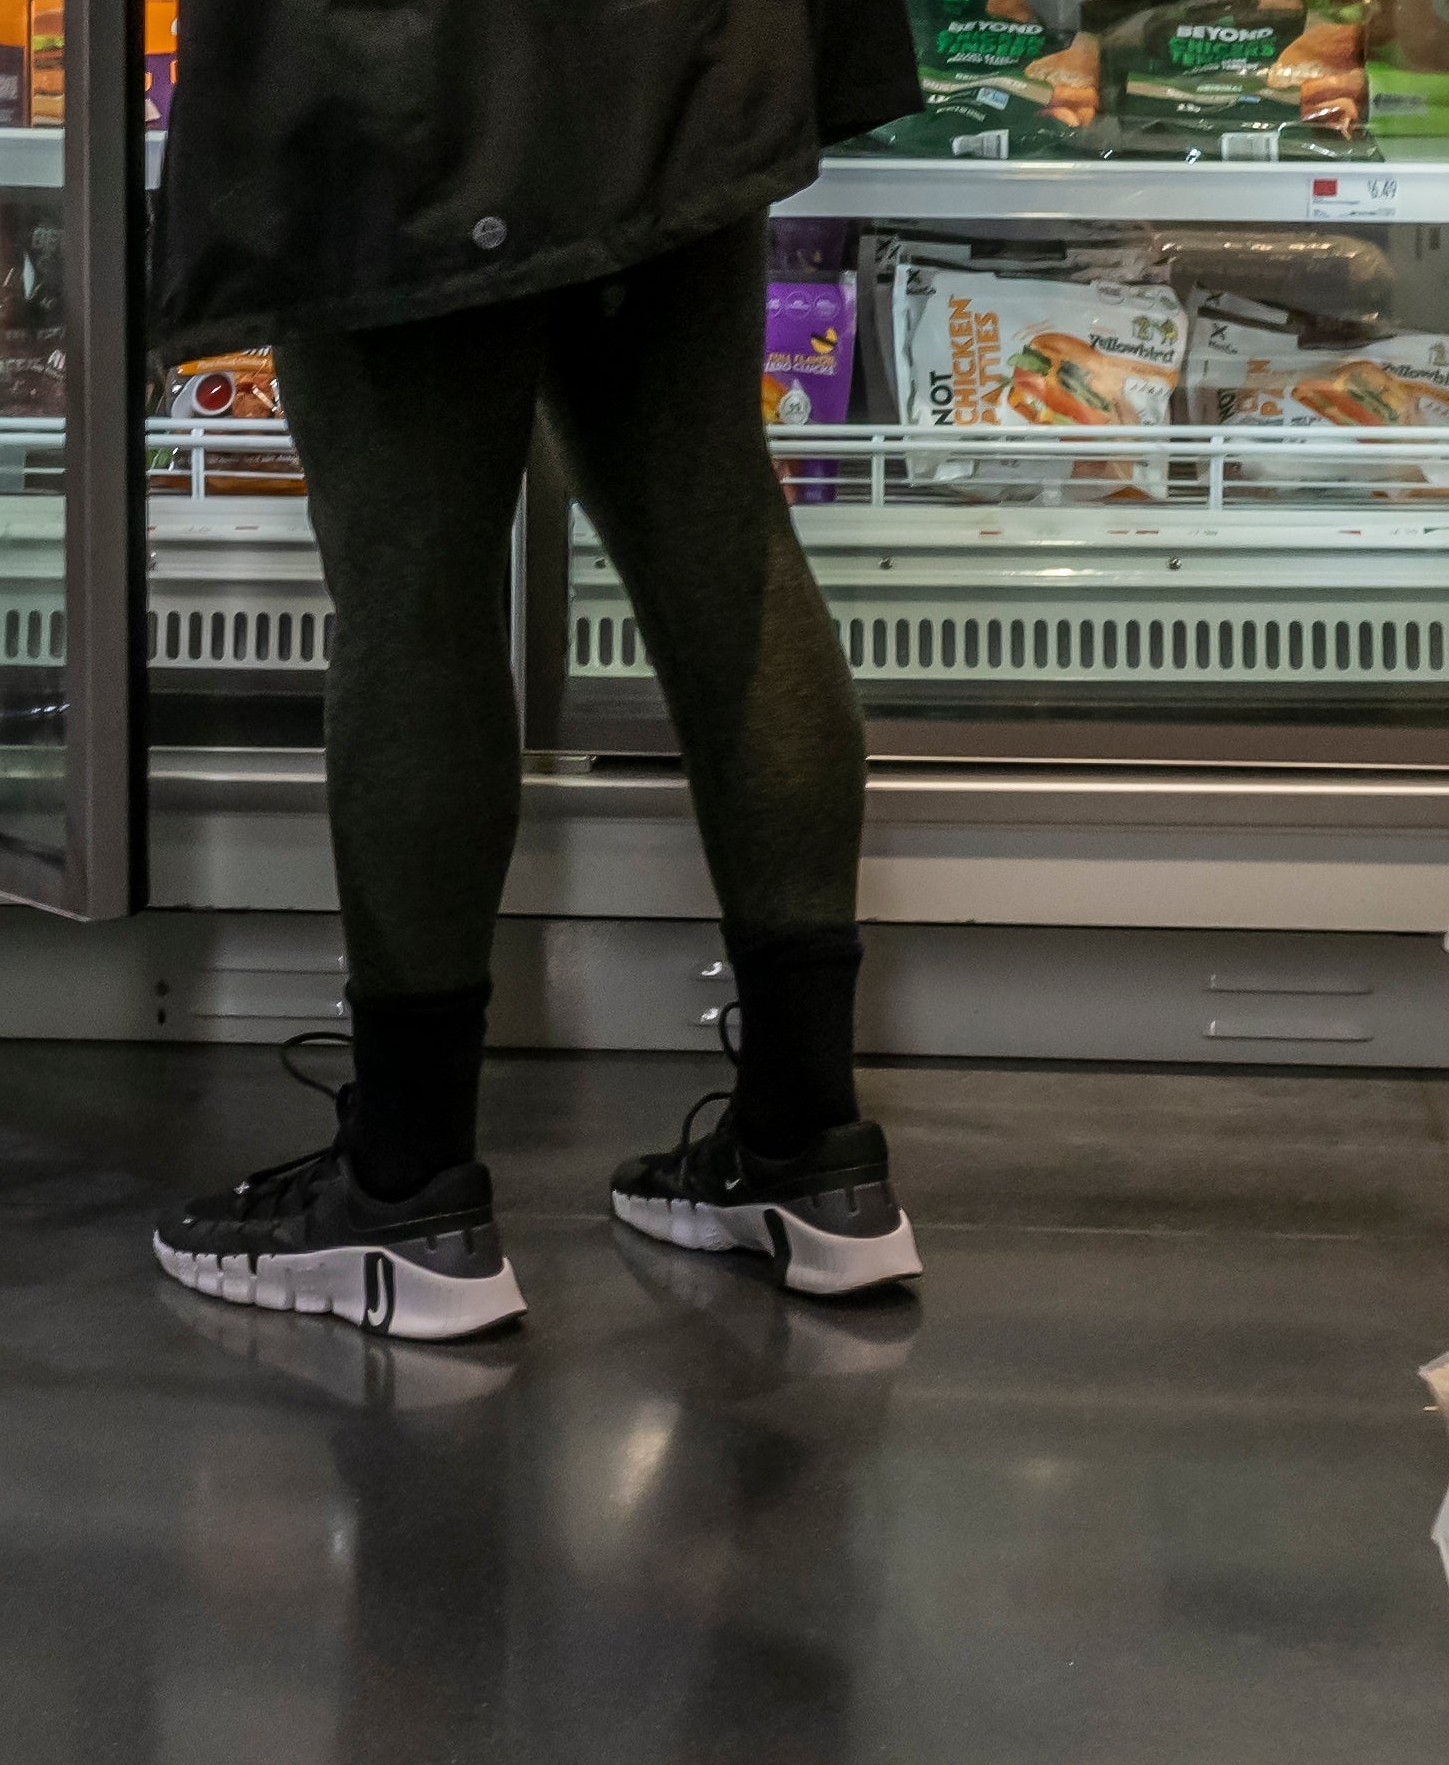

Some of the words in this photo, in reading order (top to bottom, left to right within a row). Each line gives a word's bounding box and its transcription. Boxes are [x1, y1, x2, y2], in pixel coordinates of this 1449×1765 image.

[948, 20, 1044, 36] BEYOND
[1177, 25, 1275, 43] BEYOND
[953, 295, 976, 426] CHICKEN
[979, 311, 1003, 426] PATTIES
[931, 370, 953, 426] NOT
